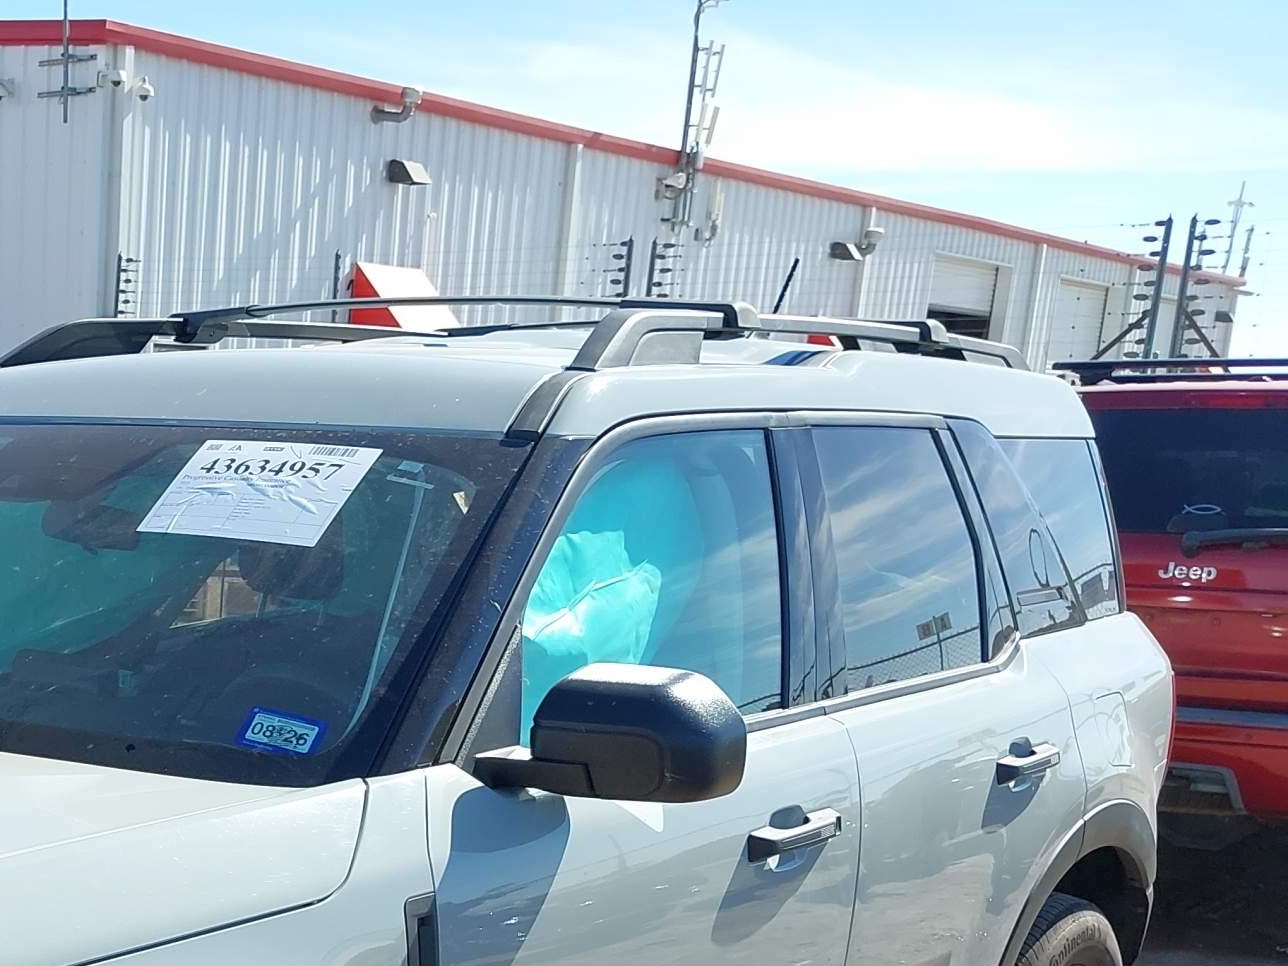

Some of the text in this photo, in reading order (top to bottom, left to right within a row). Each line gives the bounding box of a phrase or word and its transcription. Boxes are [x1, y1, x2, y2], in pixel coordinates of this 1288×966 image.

[200, 458, 346, 481] 43634957
[1158, 561, 1218, 583] Jeep
[251, 722, 275, 738] 08
[281, 729, 309, 746] 26
